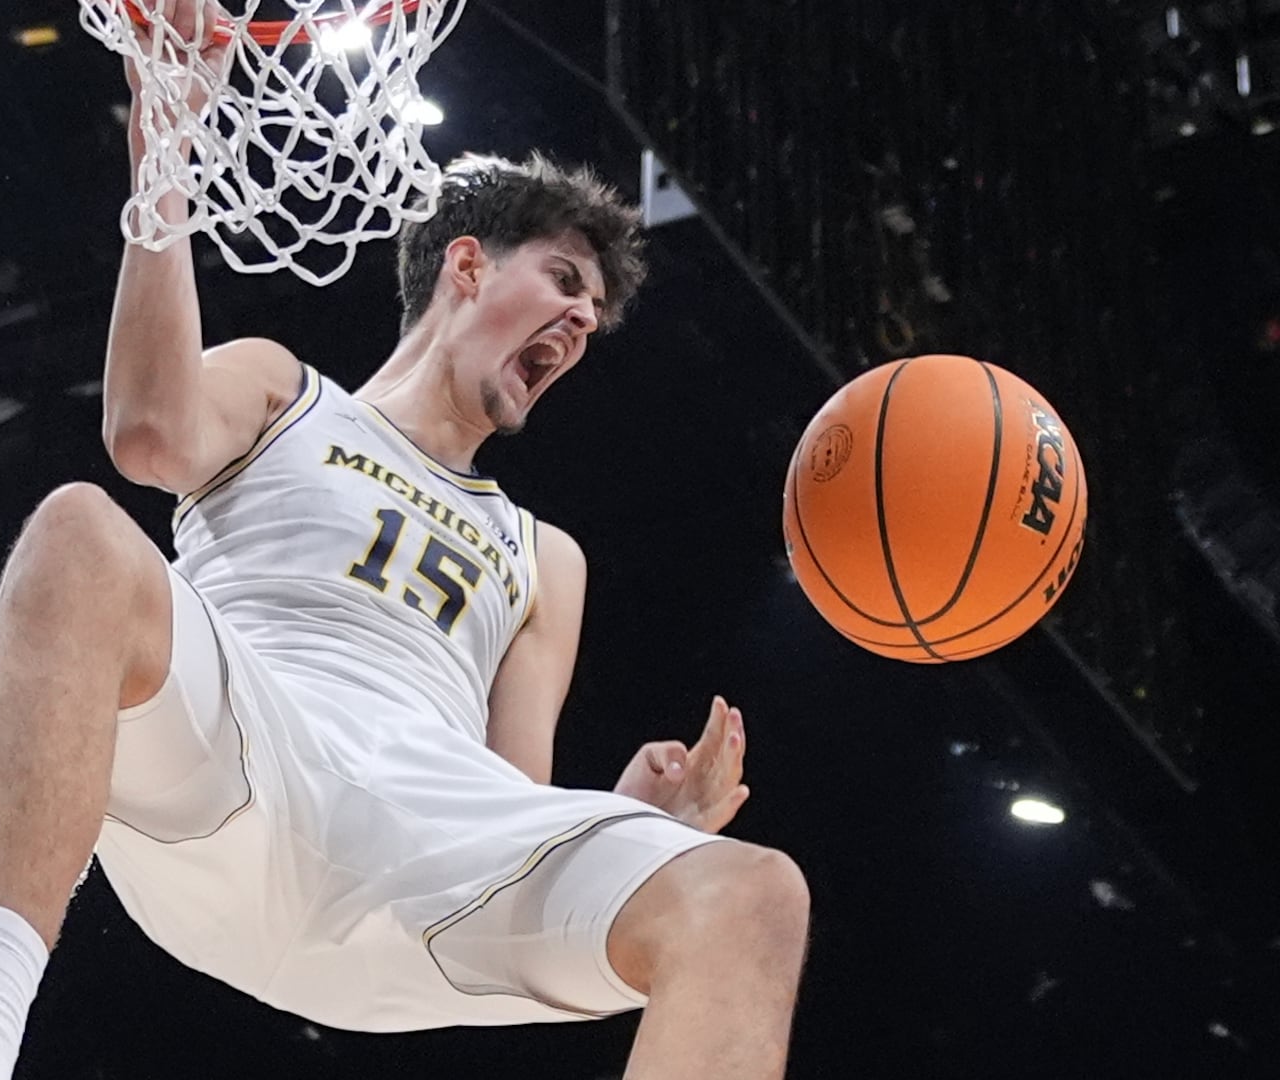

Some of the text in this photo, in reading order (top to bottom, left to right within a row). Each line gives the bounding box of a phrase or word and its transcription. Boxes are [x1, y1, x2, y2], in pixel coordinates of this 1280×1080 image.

[324, 444, 520, 608] MICHIGAN
[1020, 398, 1064, 536] NCAA
[347, 507, 484, 637] 15
